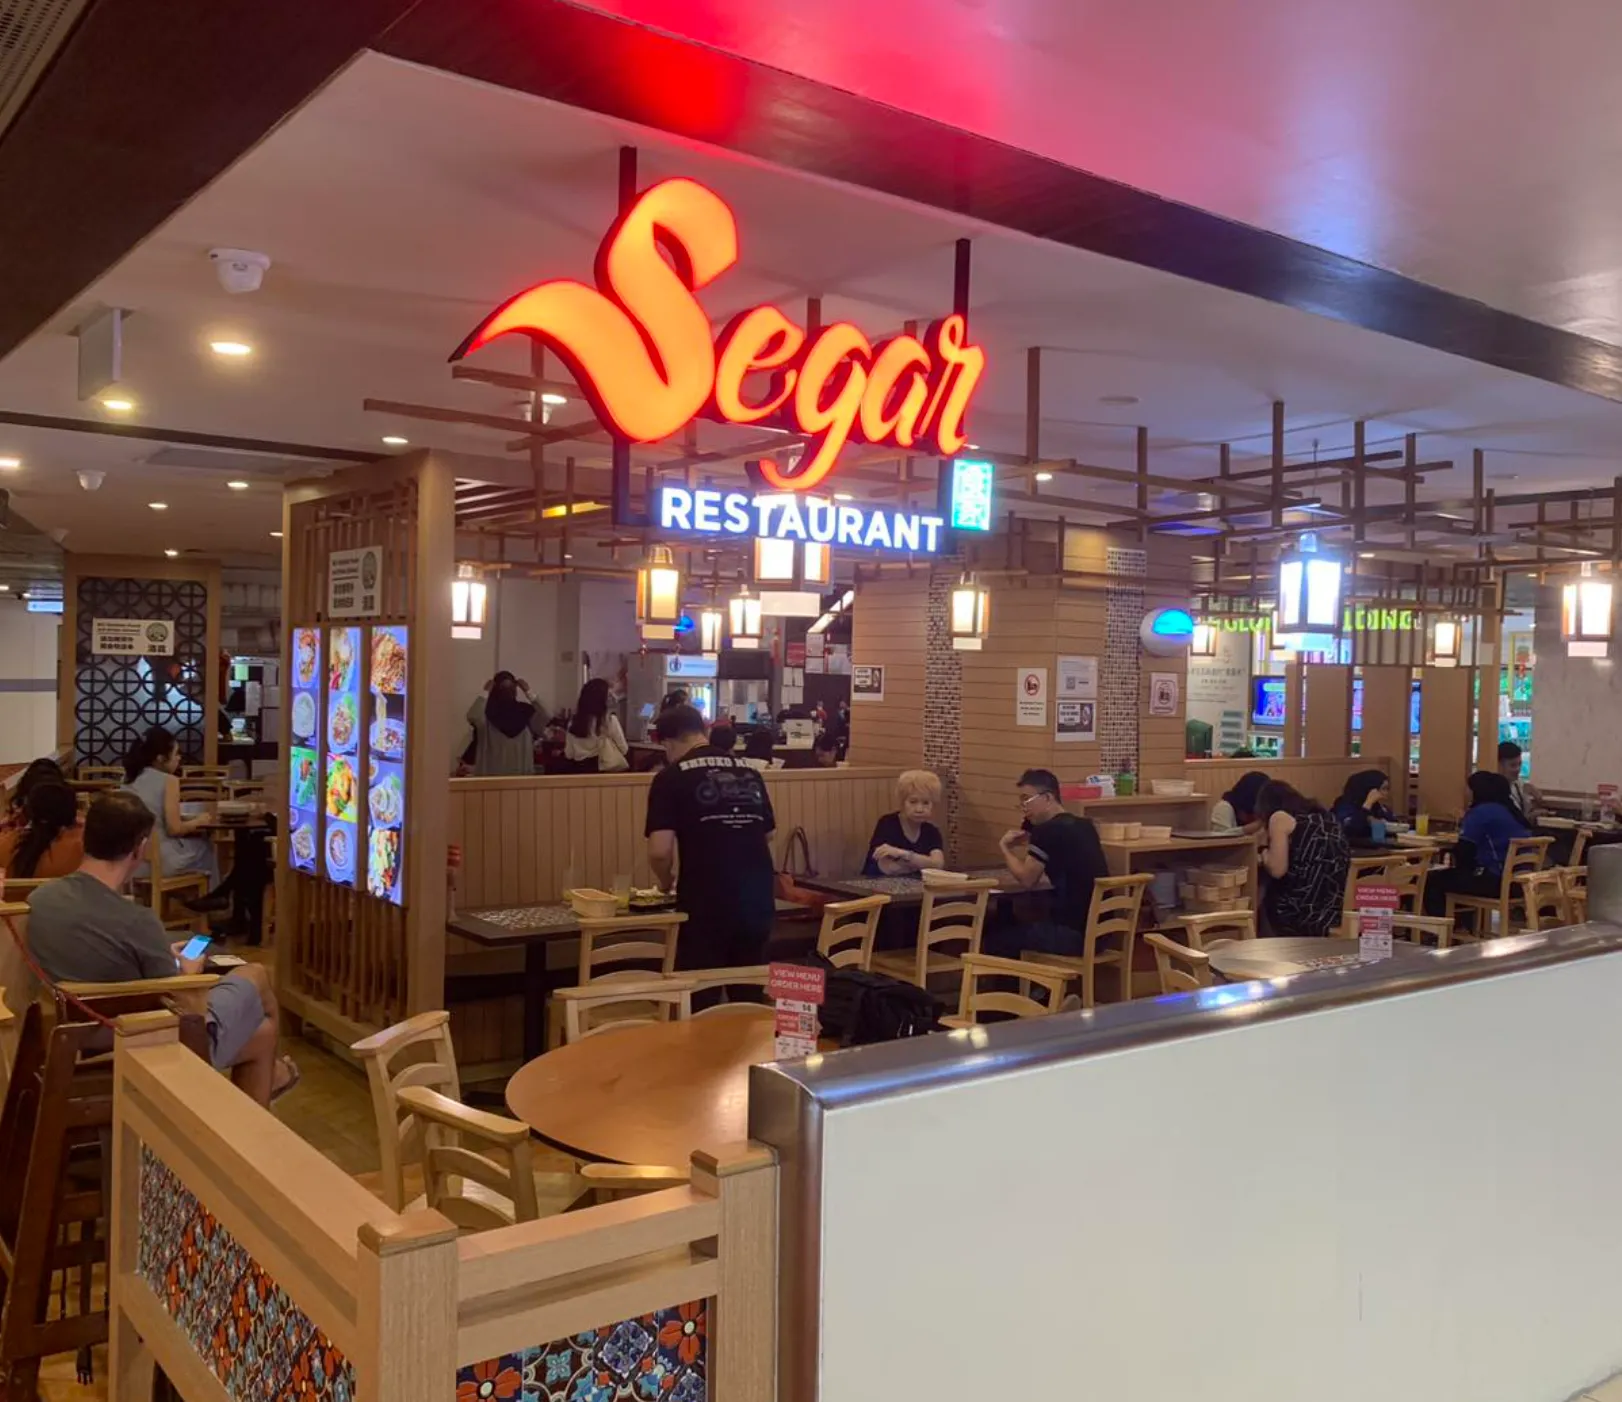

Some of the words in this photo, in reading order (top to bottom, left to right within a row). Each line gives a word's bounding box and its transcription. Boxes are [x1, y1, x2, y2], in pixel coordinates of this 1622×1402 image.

[447, 177, 985, 490] Segar
[660, 486, 944, 553] RESTAURANT
[771, 979, 799, 990] ORDER
[773, 969, 794, 977] VIEW
[795, 971, 821, 982] MENU
